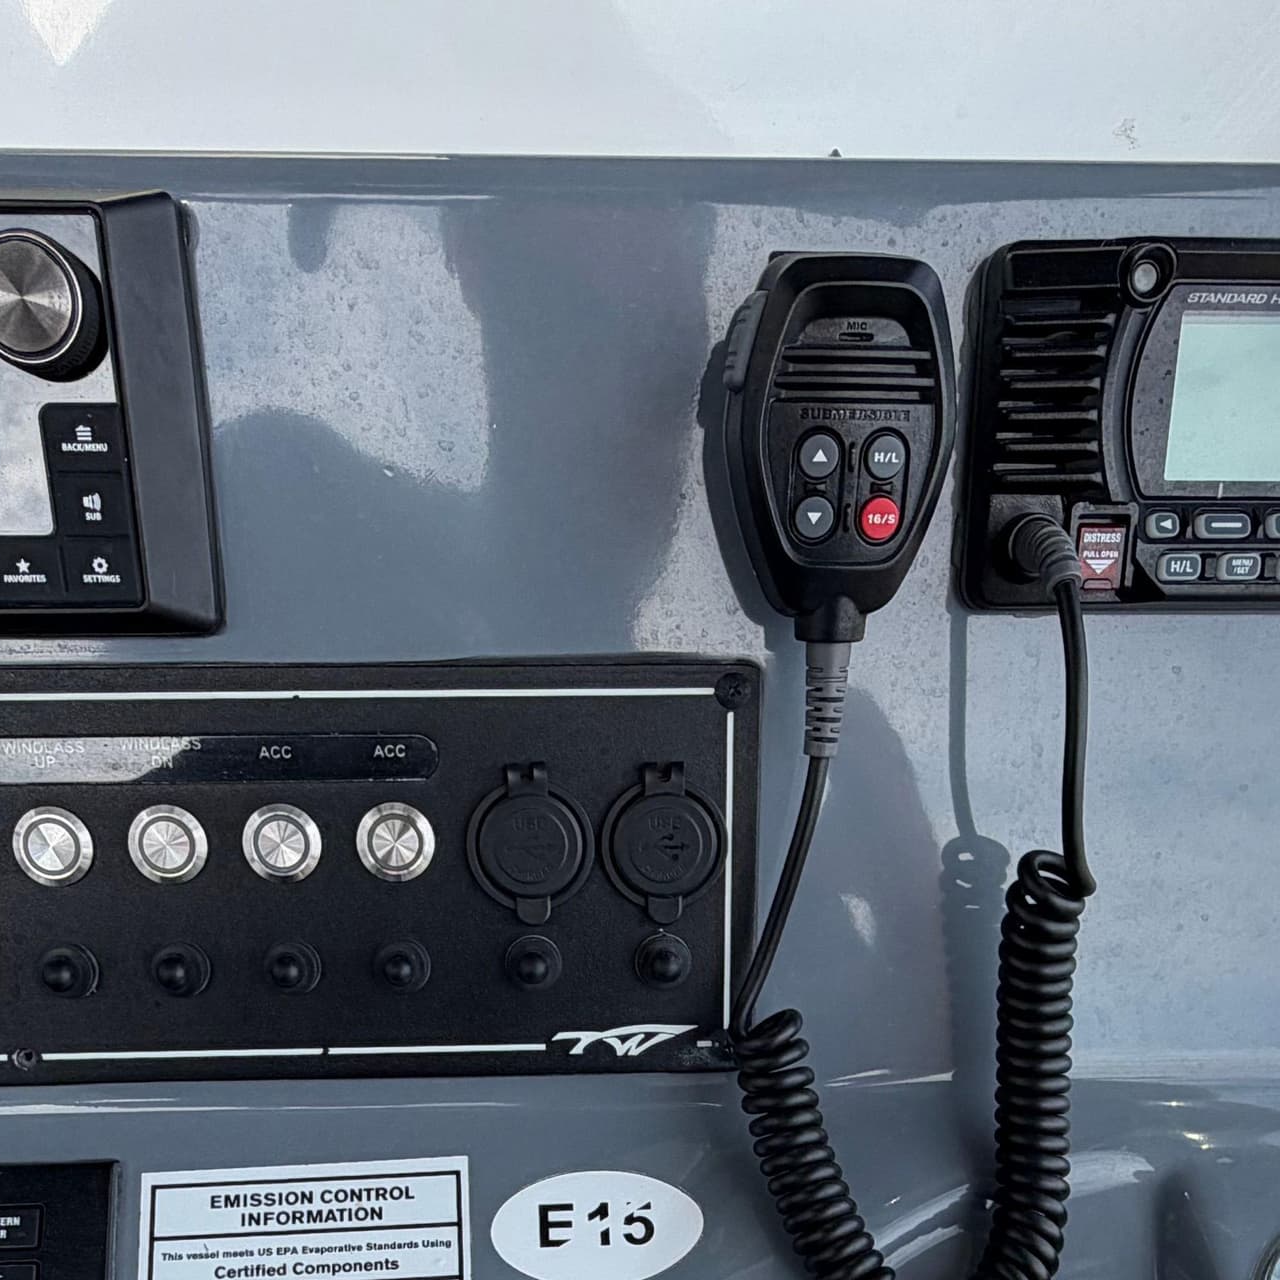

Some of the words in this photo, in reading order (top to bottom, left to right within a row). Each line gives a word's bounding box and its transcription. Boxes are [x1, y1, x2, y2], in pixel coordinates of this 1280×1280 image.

[1186, 292, 1268, 305] STANDARD
[846, 321, 868, 331] MIC
[61, 442, 109, 452] BACK/MENU
[873, 452, 900, 463] H/L
[85, 512, 102, 521] SUB
[867, 514, 896, 525] 16/S
[1083, 532, 1122, 543] DISTRESS
[1083, 550, 1100, 558] PULL
[1101, 550, 1119, 558] OPEN
[1170, 560, 1193, 573] H/L
[1231, 559, 1254, 567] MENU
[3, 574, 47, 583] FAVORITES
[83, 574, 121, 583] SETTINGS
[2, 740, 86, 755] WINDLASS
[259, 745, 293, 760] ACC
[373, 744, 407, 758] ACC
[33, 755, 57, 769] UP
[151, 755, 174, 769] DN
[210, 1190, 314, 1209] EMISSION
[320, 1186, 415, 1204] CONTROL
[241, 1206, 383, 1227] INFORMATION
[538, 1200, 655, 1248] E15
[161, 1252, 184, 1261] This
[186, 1250, 220, 1260] vessel
[222, 1249, 255, 1258] meets
[257, 1247, 273, 1256] US
[276, 1246, 299, 1255] EPA
[301, 1243, 363, 1255] Evaporative
[366, 1240, 419, 1251] Standards
[421, 1239, 452, 1249] Using
[214, 1263, 287, 1279] Certified
[292, 1258, 400, 1276] Components
